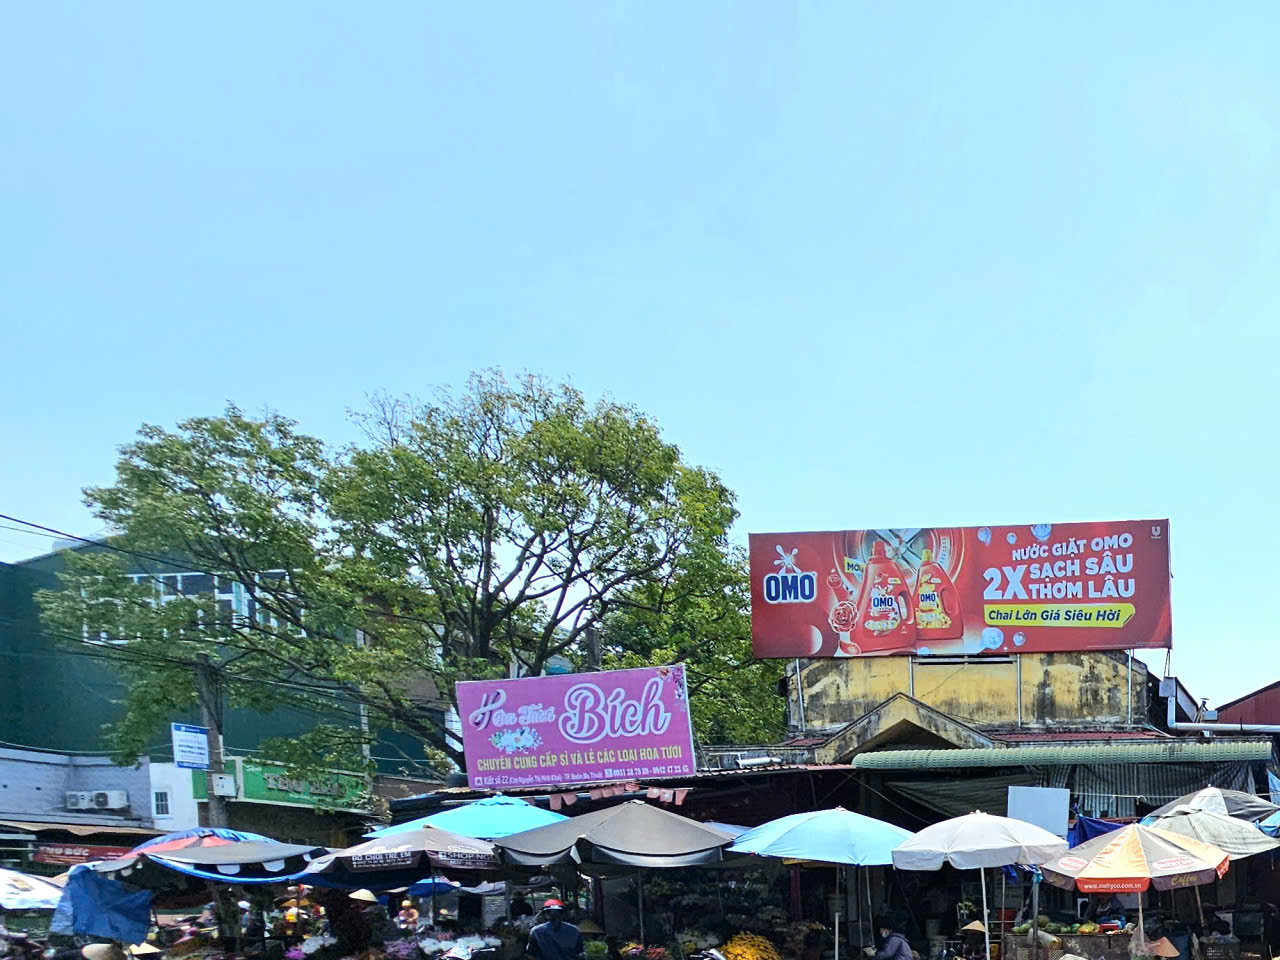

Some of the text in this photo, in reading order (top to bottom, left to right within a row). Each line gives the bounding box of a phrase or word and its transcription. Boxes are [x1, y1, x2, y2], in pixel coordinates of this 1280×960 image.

[1012, 533, 1133, 561] NƯỚC GIẶT OMO
[1029, 551, 1134, 582] SẠCH SÂU
[765, 574, 815, 602] OMO
[983, 565, 1029, 600] 2X
[1028, 575, 1135, 599] THƠM LÂU
[873, 597, 894, 608] OMO
[920, 593, 936, 603] OMO
[988, 608, 1121, 622] Chai Lớn Giá Siêu Hời
[558, 677, 673, 744] Bích
[513, 755, 538, 769] CUNG
[597, 749, 616, 764] CÁC
[617, 748, 638, 764] LOẠI
[640, 747, 660, 761] HOA
[661, 746, 683, 760] TƯƠI
[502, 776, 509, 784] 22
[1171, 874, 1198, 886] Coffee
